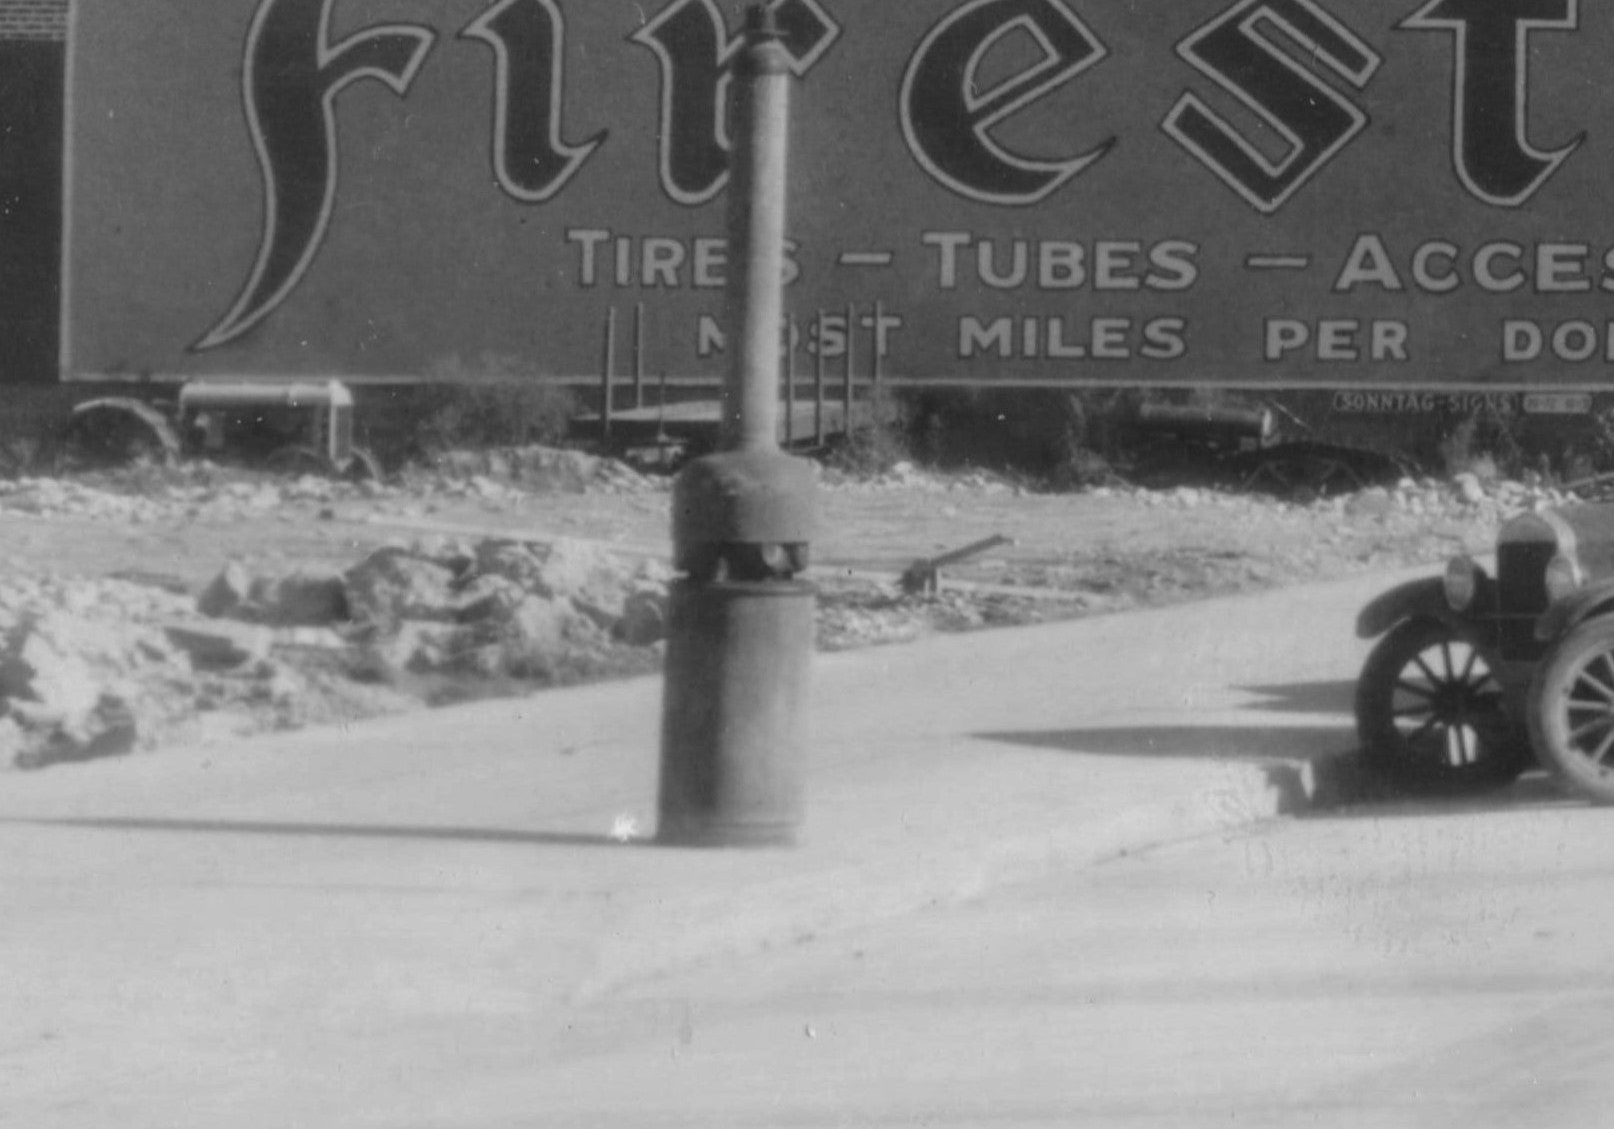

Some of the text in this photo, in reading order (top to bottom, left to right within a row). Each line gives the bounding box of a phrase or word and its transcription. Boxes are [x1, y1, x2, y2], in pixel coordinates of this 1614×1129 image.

[922, 231, 1198, 290] TUBES
[958, 317, 1186, 360] MILES
[1263, 319, 1409, 361] PER
